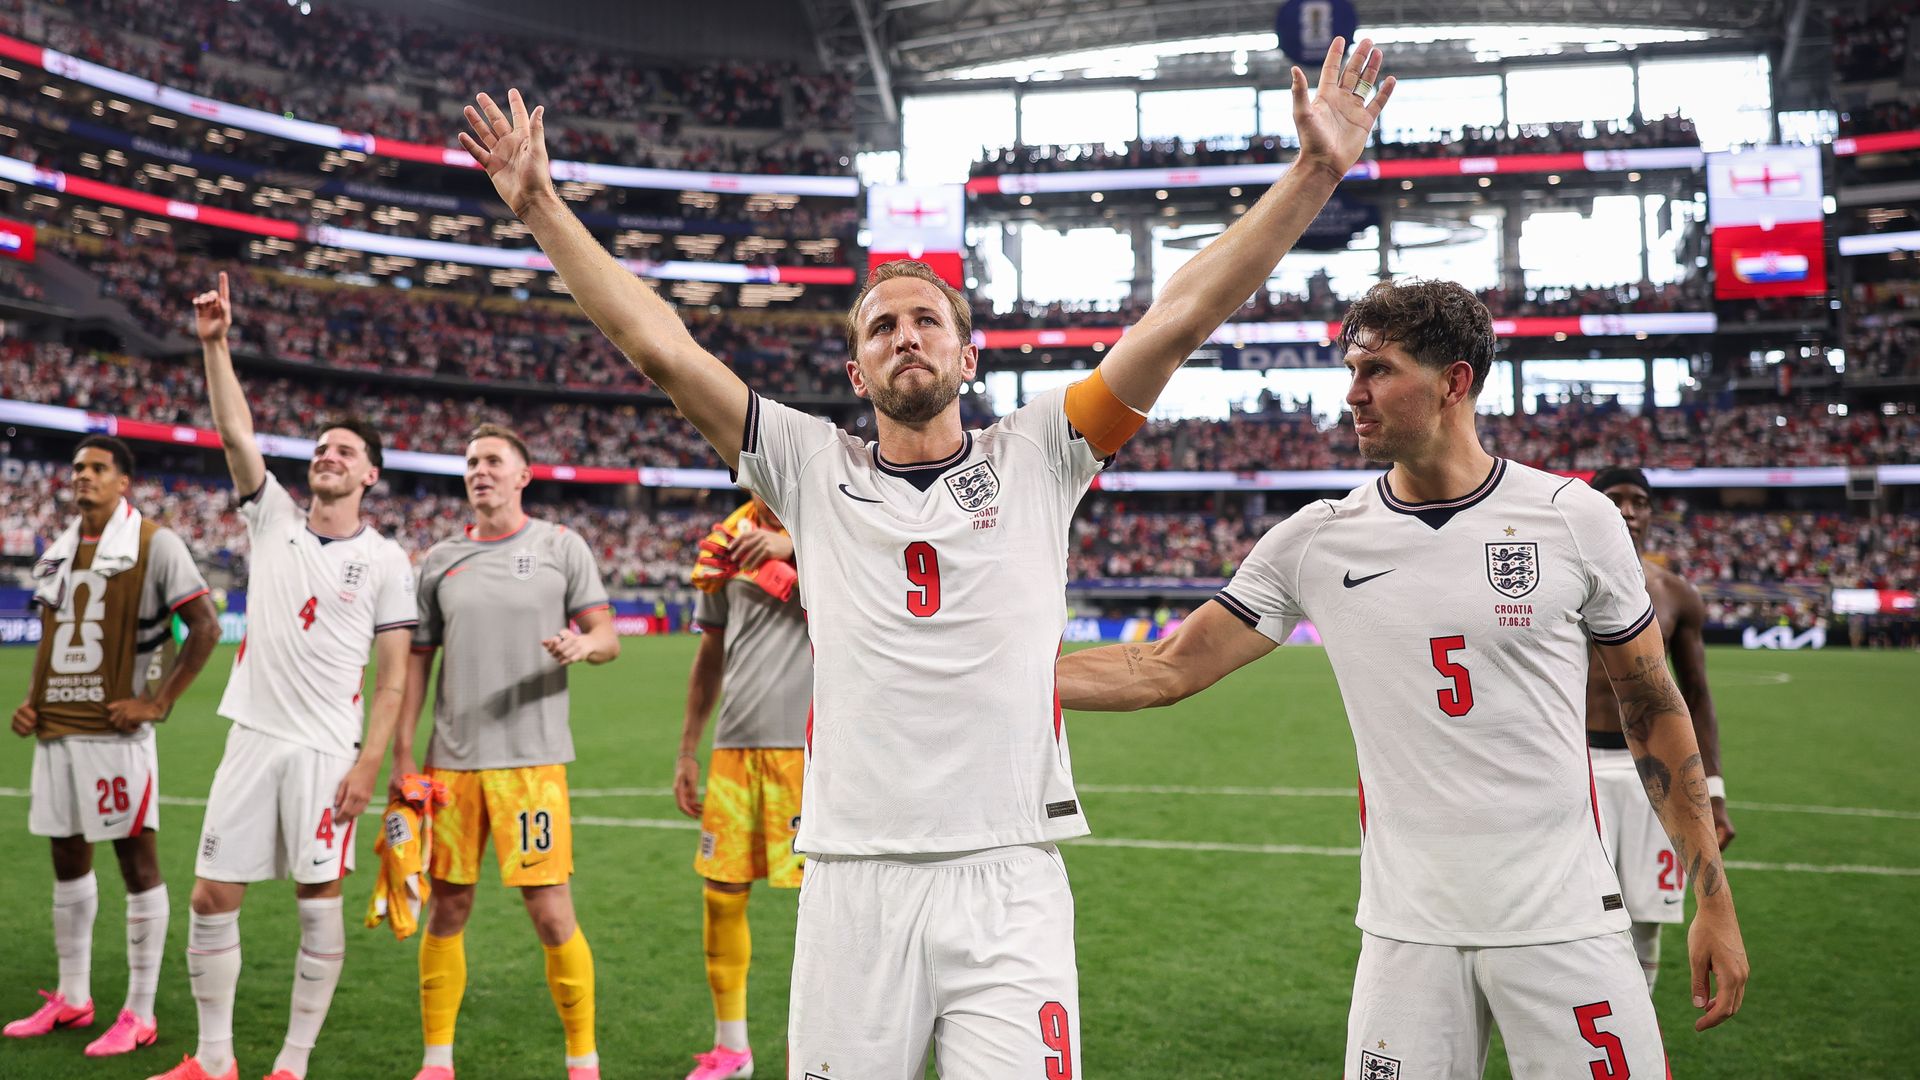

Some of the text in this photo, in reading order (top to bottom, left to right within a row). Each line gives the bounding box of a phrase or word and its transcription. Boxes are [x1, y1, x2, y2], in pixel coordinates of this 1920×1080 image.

[904, 541, 941, 617] 9
[299, 596, 317, 631] 4
[1494, 604, 1533, 615] CROATIA
[1498, 616, 1531, 627] 17.06.26
[63, 652, 87, 665] FIFA
[1429, 635, 1474, 717] 5
[45, 686, 105, 703] 2026
[47, 674, 104, 688] WORLD CUP
[96, 776, 131, 815] 26
[316, 807, 334, 849] 4
[519, 810, 551, 852] 13
[1038, 1001, 1073, 1080] 9
[1573, 1000, 1631, 1080] 5
